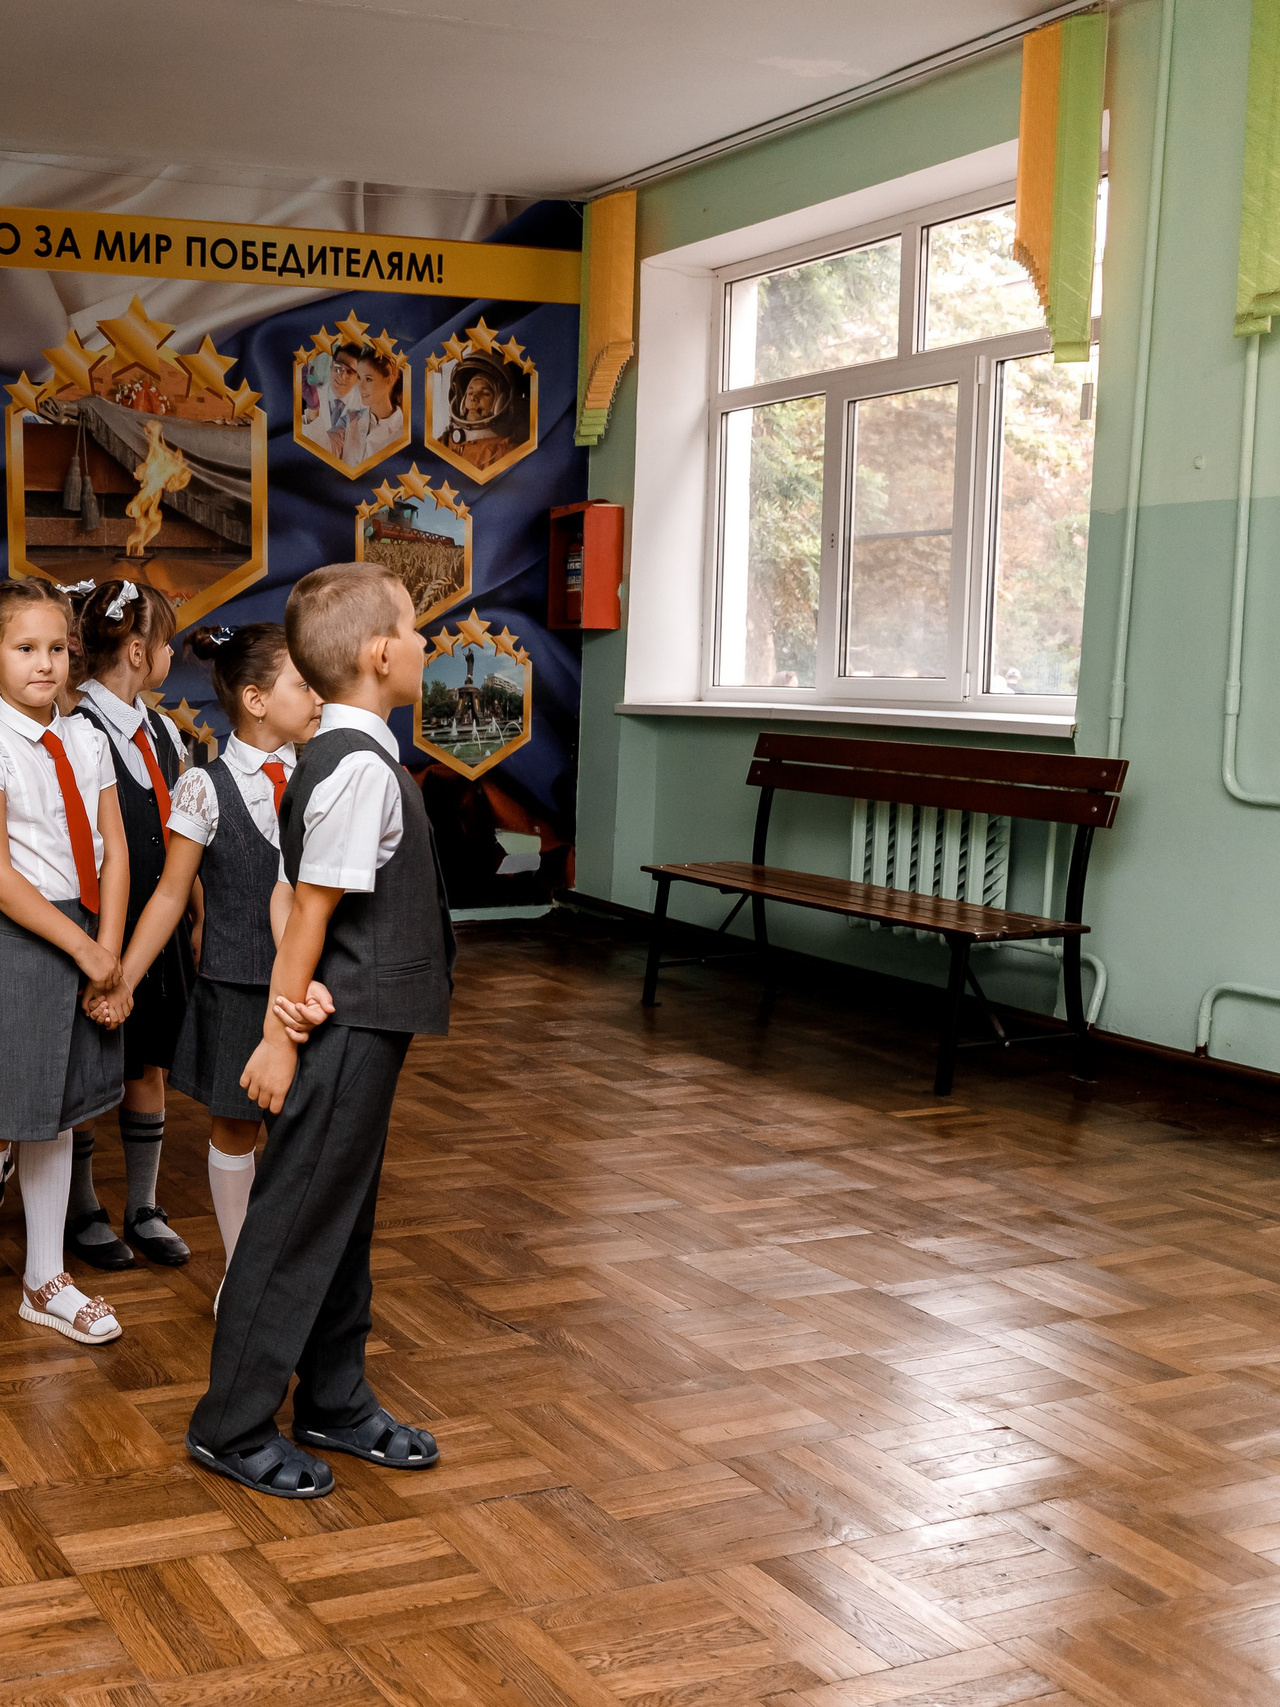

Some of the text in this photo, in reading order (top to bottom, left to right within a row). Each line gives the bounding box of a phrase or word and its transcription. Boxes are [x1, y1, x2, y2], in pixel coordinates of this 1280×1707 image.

[33, 224, 81, 260] ЗА
[94, 229, 172, 265] МИР
[186, 236, 443, 284] ПОБЕДИТЕЛЯМ!
